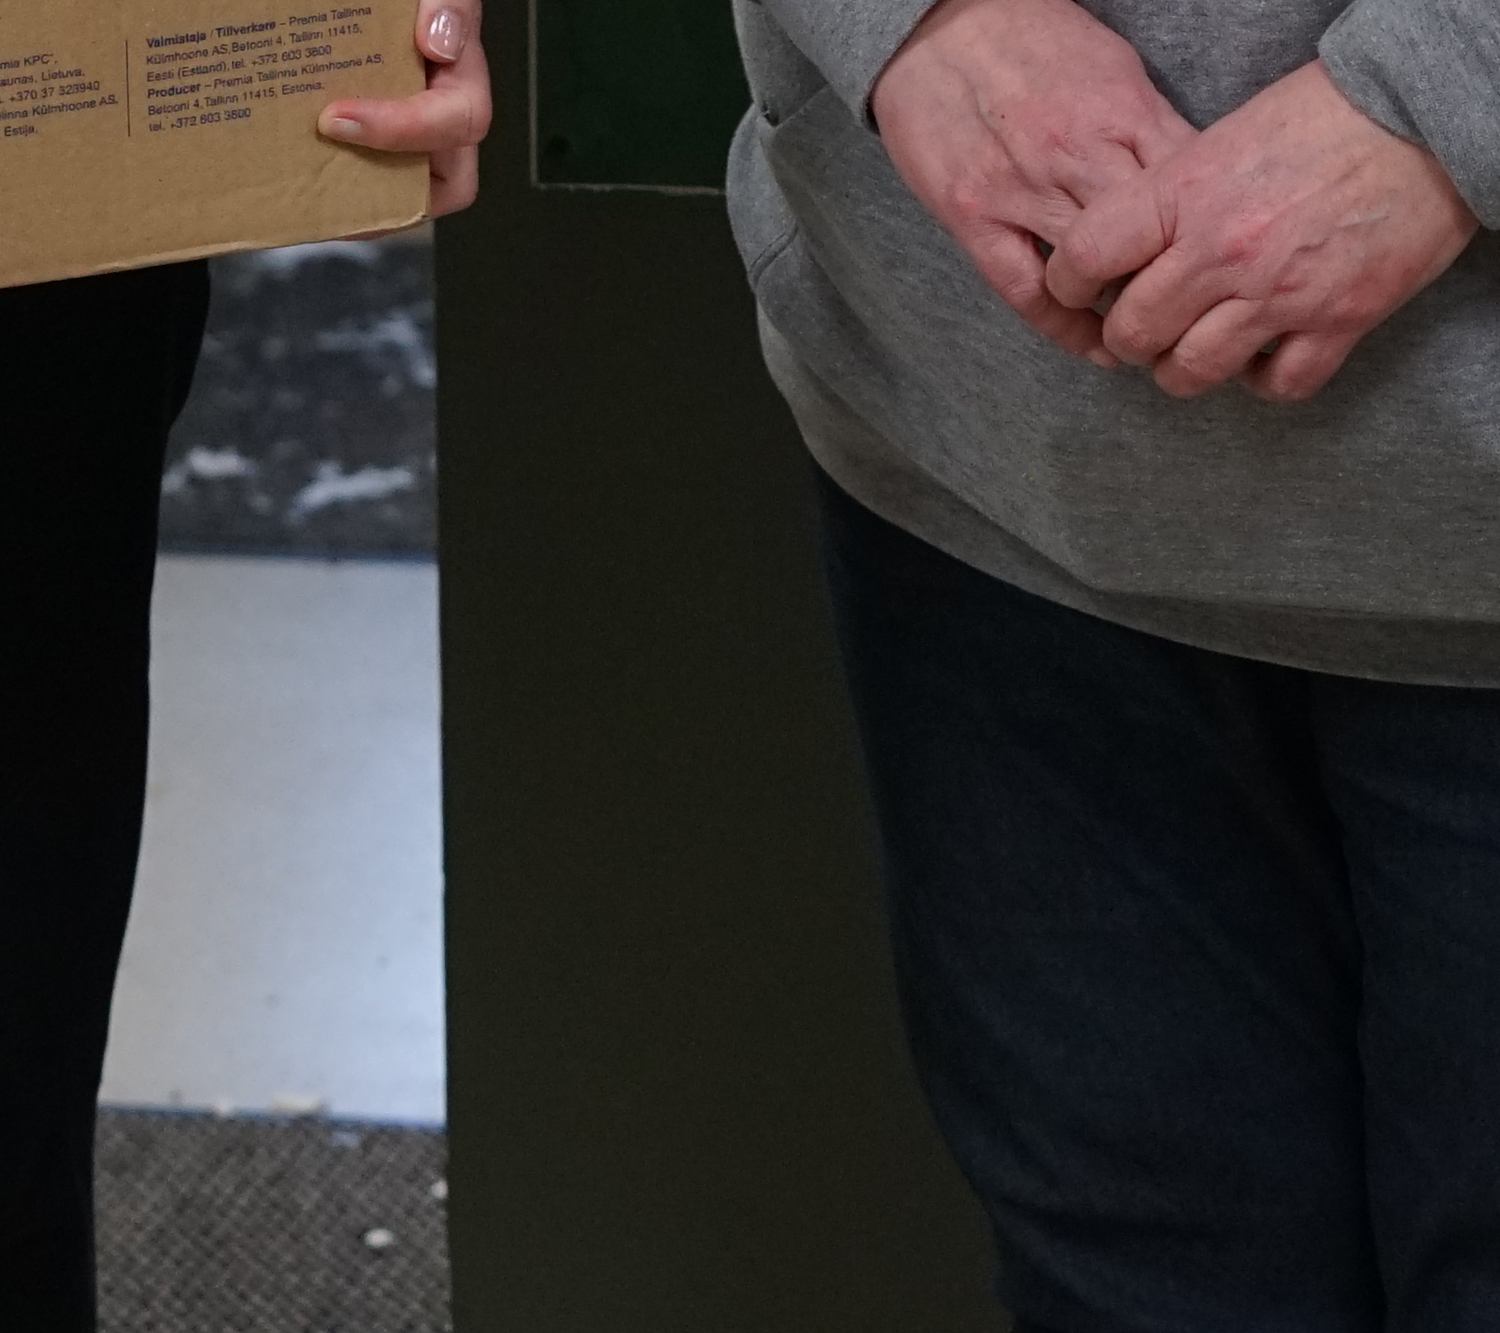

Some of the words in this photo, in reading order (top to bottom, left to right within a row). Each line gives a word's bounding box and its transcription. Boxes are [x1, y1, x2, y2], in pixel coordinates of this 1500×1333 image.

[146, 32, 206, 49] Valmistaja
[216, 21, 276, 38] Tillverkare
[289, 14, 327, 26] Premia
[331, 7, 371, 20] Tallinna
[148, 84, 201, 98] Producer
[214, 76, 253, 90] Premia
[257, 68, 297, 82] Tallinna
[301, 57, 362, 75] Külmhoone
[365, 54, 384, 64] AS,
[32, 101, 96, 117] Külmhoone
